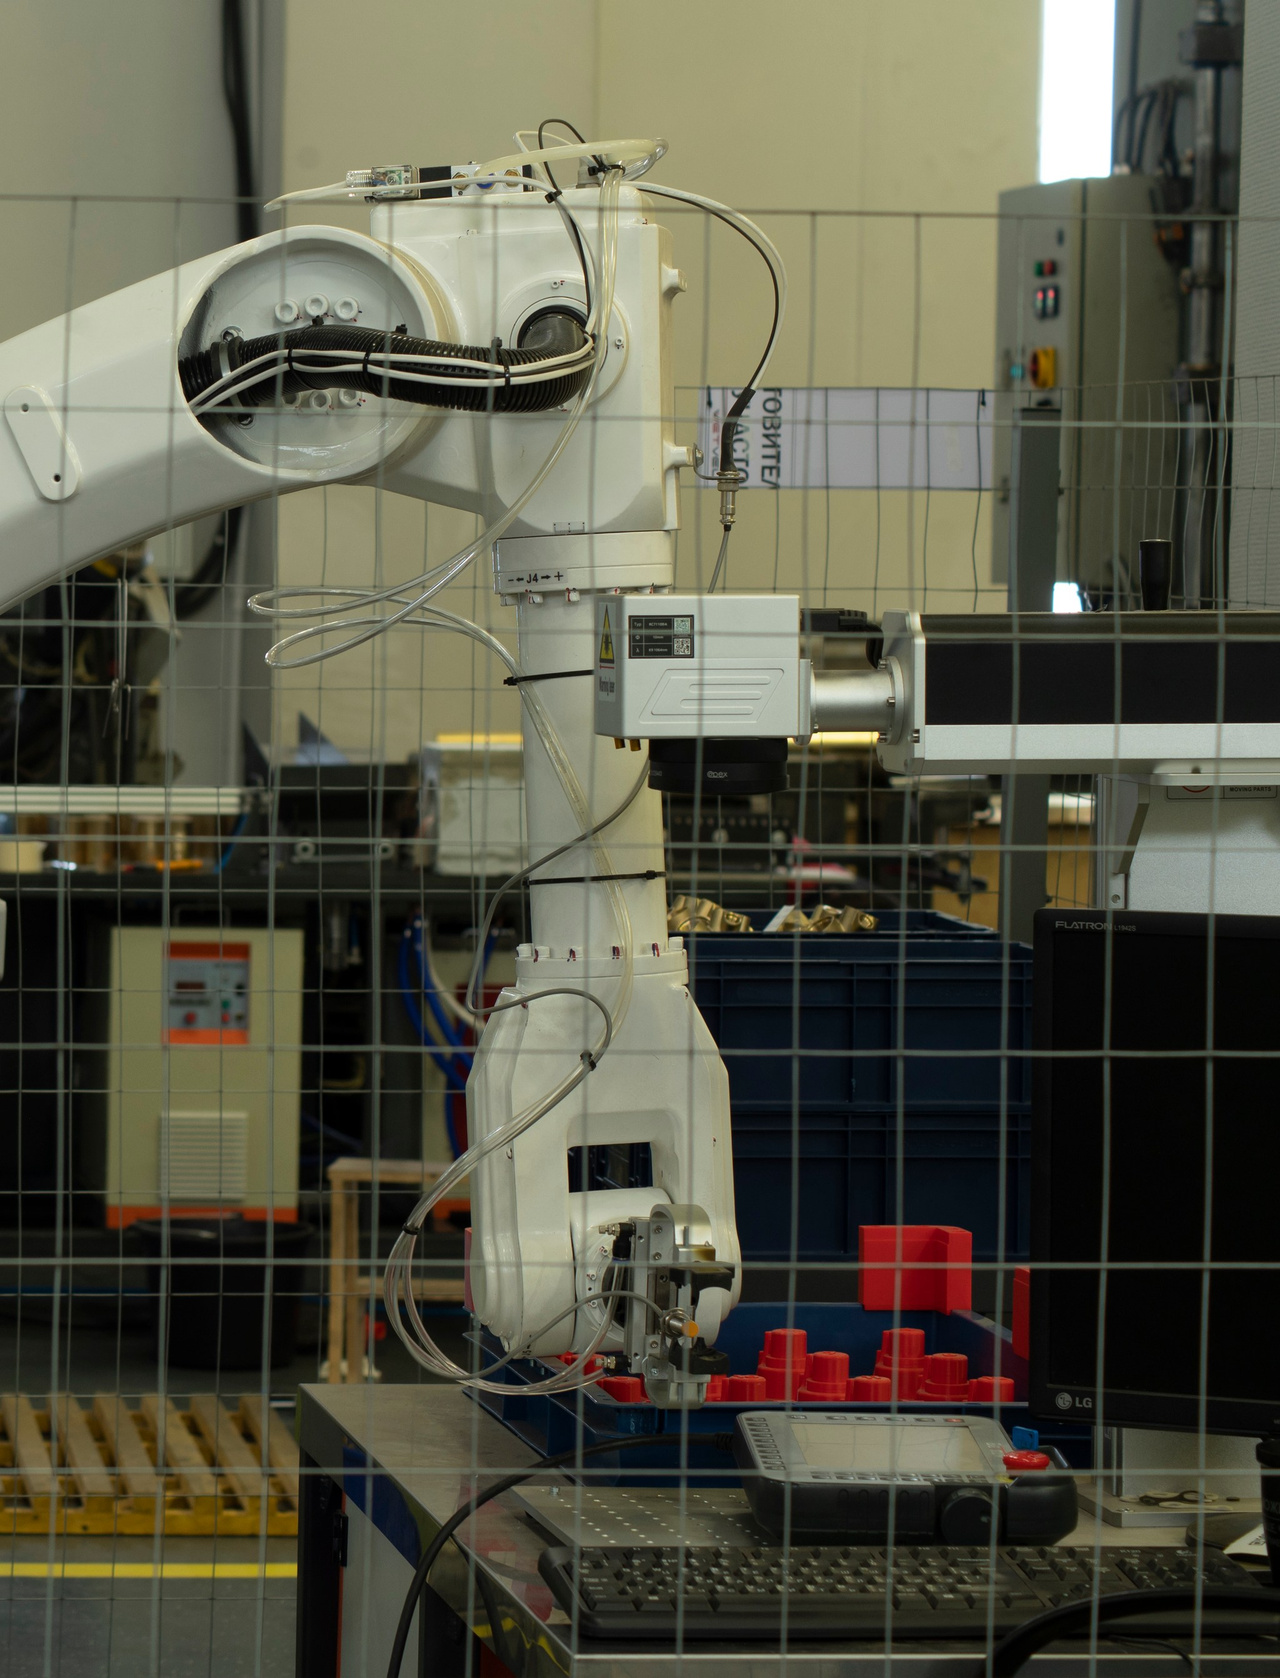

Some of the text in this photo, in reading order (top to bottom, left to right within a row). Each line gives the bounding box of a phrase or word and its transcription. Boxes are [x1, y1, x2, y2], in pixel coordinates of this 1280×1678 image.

[526, 573, 538, 583] J4
[1055, 920, 1113, 930] FLATRON
[1075, 1396, 1093, 1409] LG
